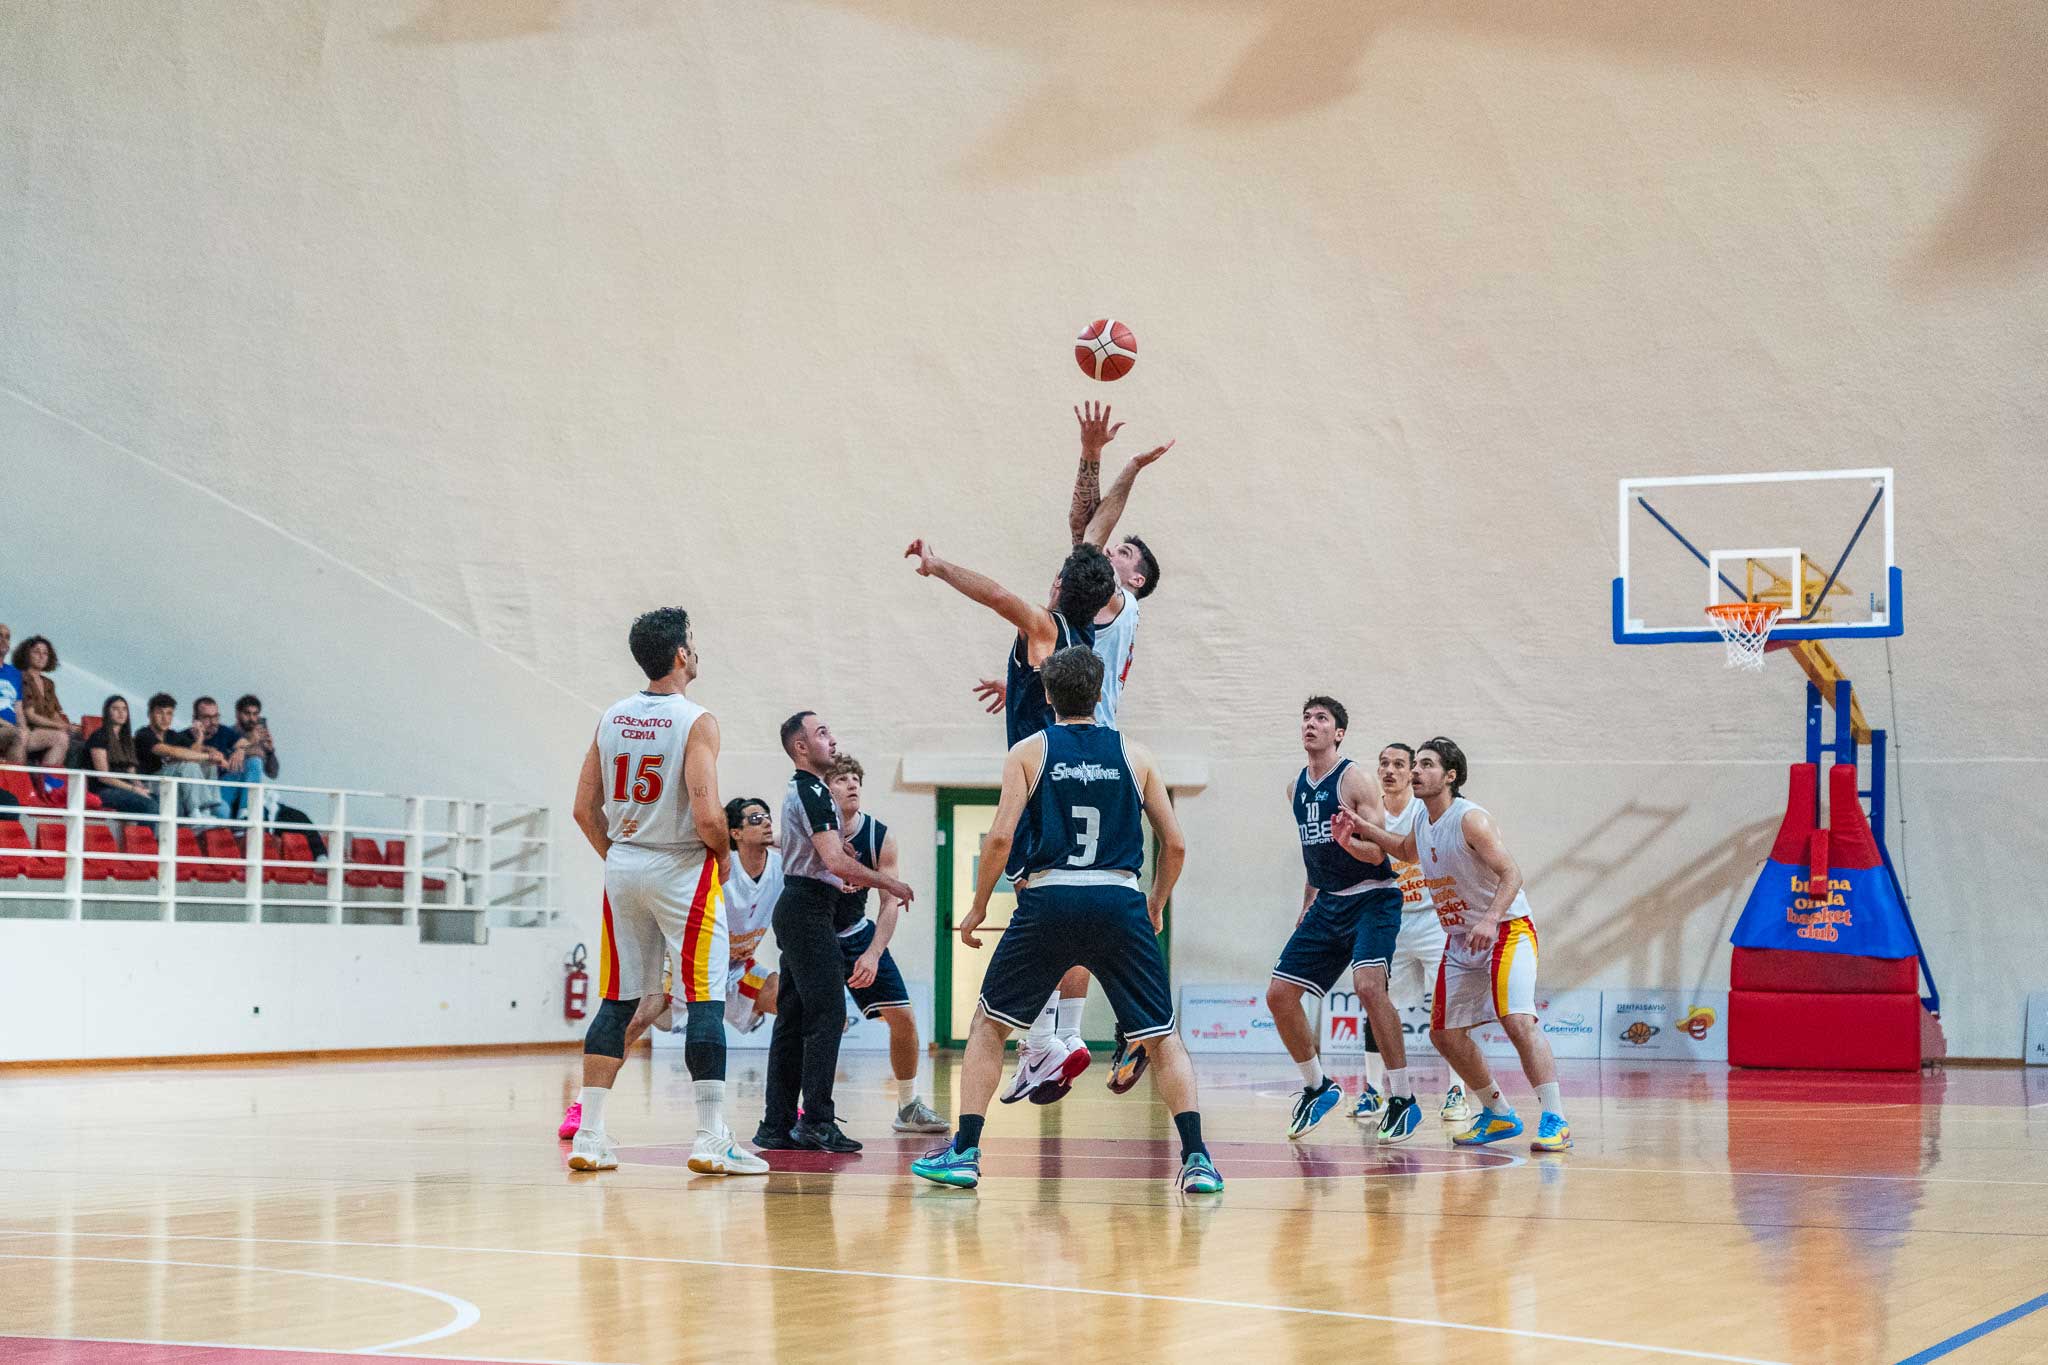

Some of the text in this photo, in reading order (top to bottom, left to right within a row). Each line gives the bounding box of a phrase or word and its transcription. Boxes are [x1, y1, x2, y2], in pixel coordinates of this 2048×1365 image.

[613, 715, 672, 728] CESENATICO
[621, 729, 656, 740] CERVIA
[612, 752, 664, 805] 15
[1305, 802, 1320, 822] 10
[1066, 805, 1101, 867] 3
[1786, 907, 1852, 926] basket
[1796, 922, 1839, 942] club
[1543, 1023, 1593, 1034] Cesenatico
